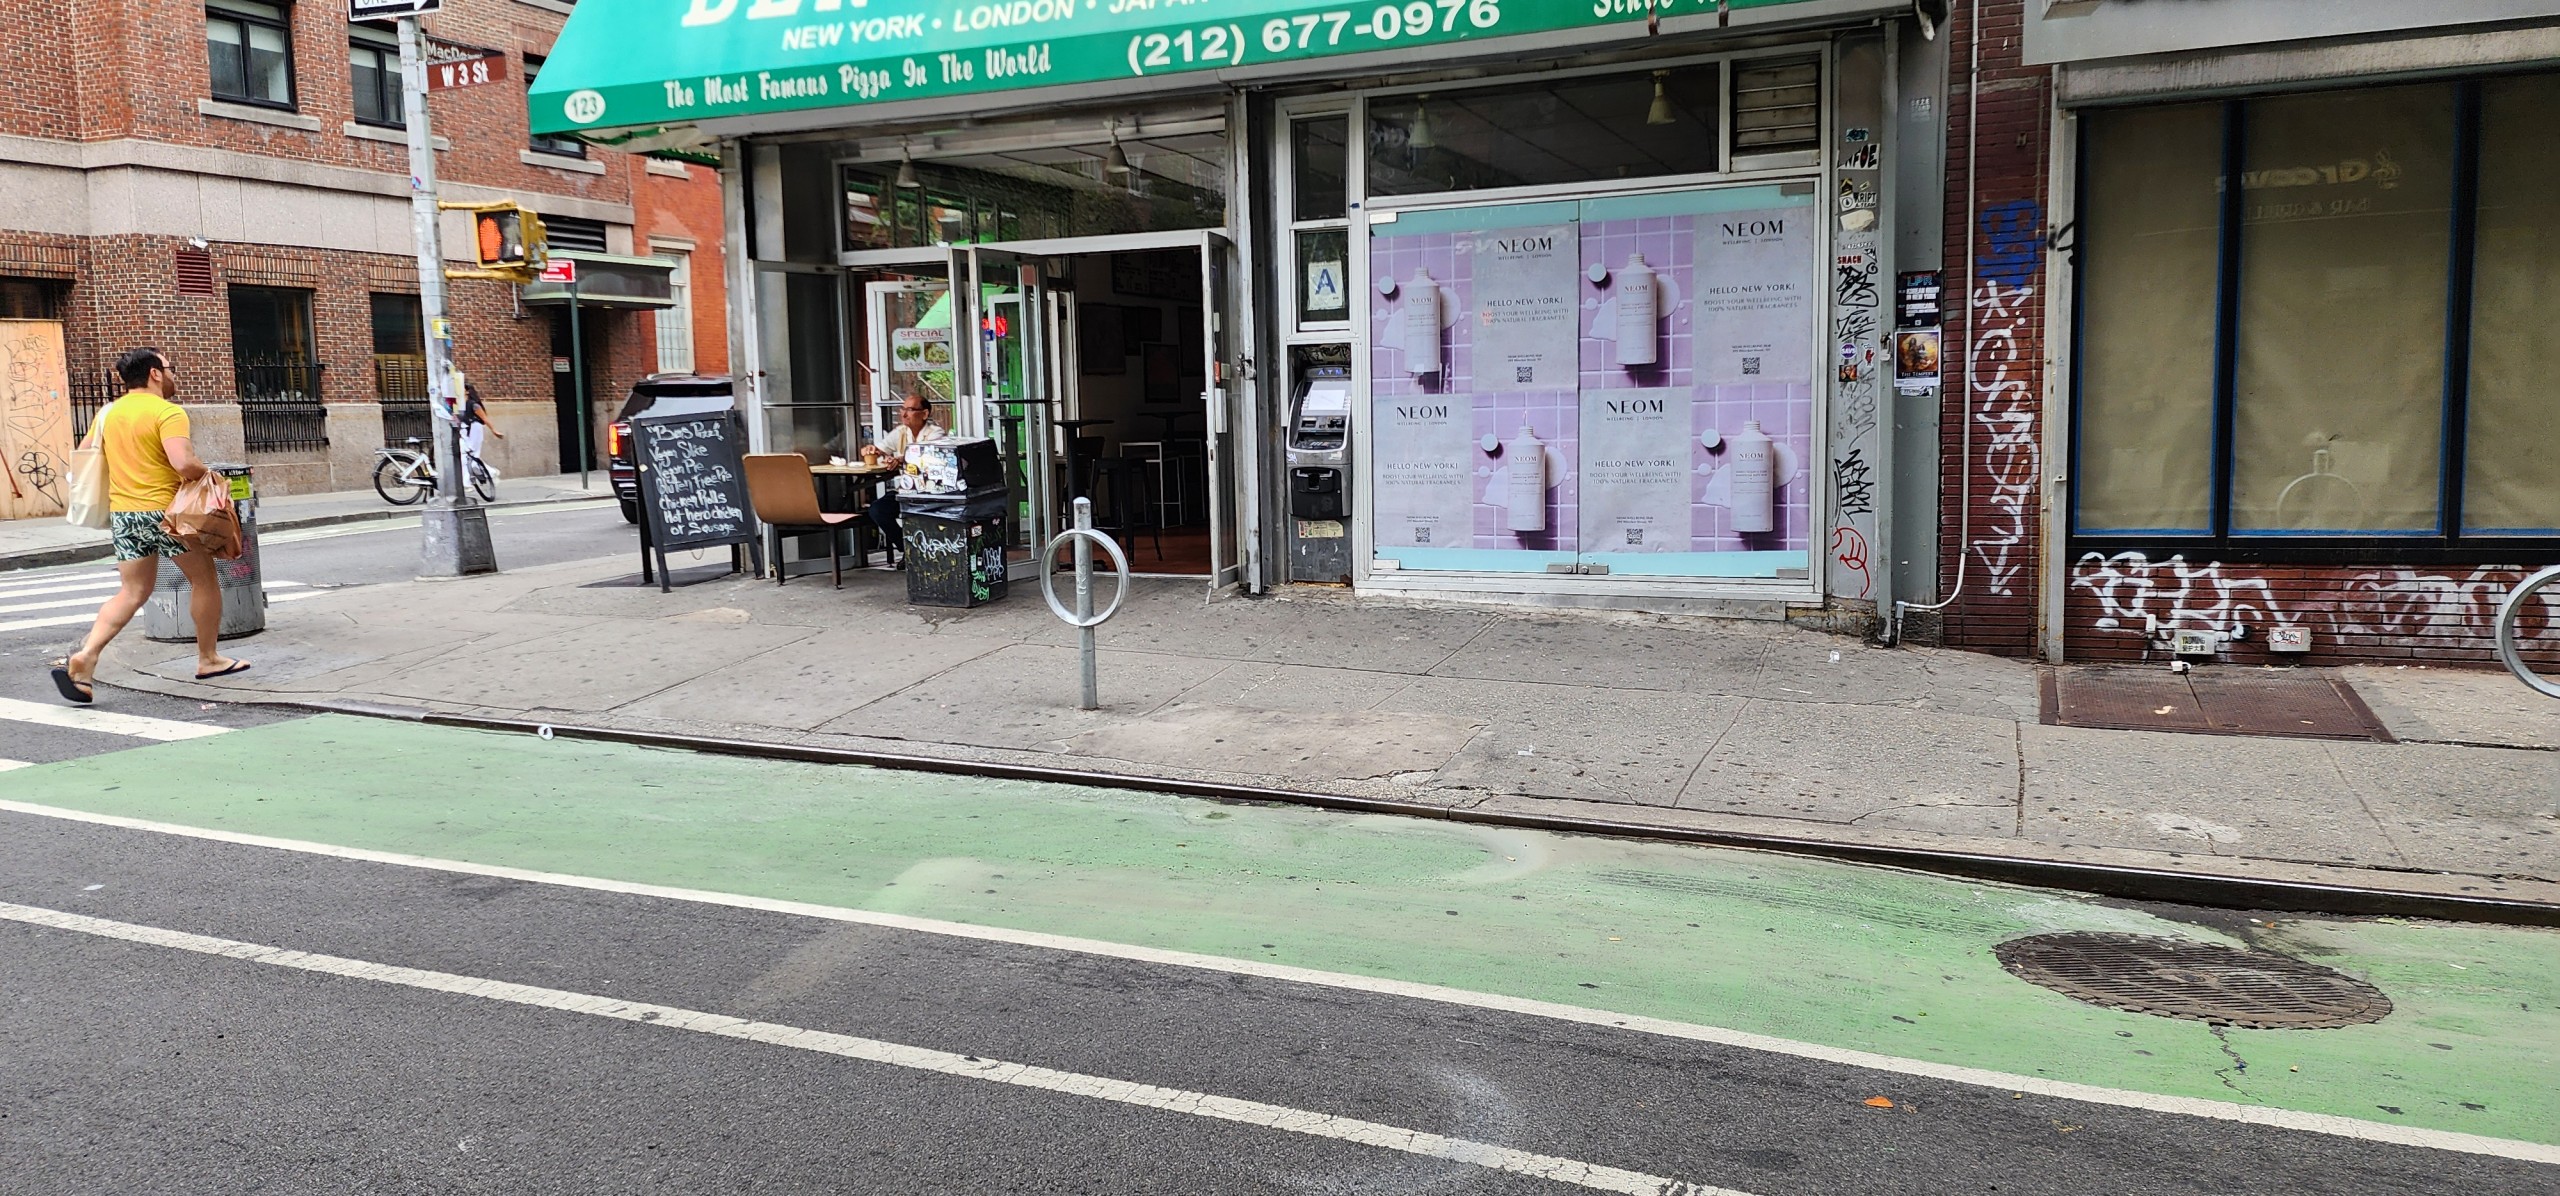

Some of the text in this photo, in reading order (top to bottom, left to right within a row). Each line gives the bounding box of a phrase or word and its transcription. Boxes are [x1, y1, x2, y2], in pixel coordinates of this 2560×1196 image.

[782, 22, 843, 51] NEW
[849, 13, 925, 43] YORK
[952, 0, 1074, 32] LONDON
[1127, 0, 1501, 76] (212) 677-0976
[441, 63, 455, 87] W
[457, 62, 469, 86] 3
[472, 59, 490, 84] St
[664, 42, 1051, 109] The Most Famous Pizza In The World
[569, 94, 597, 118] 123
[1722, 220, 1783, 238] NEOM
[1498, 237, 1552, 254] NEOM
[1315, 268, 1336, 295] A
[1709, 283, 1795, 295] HELLO NEW YORK!
[1906, 276, 1933, 286] LPR
[900, 329, 944, 338] SPECIAL
[1397, 405, 1447, 419] NEOM
[1606, 399, 1663, 414] NEOM
[648, 440, 710, 468] Vegan Slice
[681, 458, 709, 475] Pie
[1434, 462, 1458, 470] YORK!
[1648, 459, 1675, 467] YORK!
[711, 465, 733, 482] Pie
[695, 488, 728, 510] Rolls
[663, 508, 686, 524] Hot
[683, 507, 711, 522] hero
[669, 522, 686, 536] or
